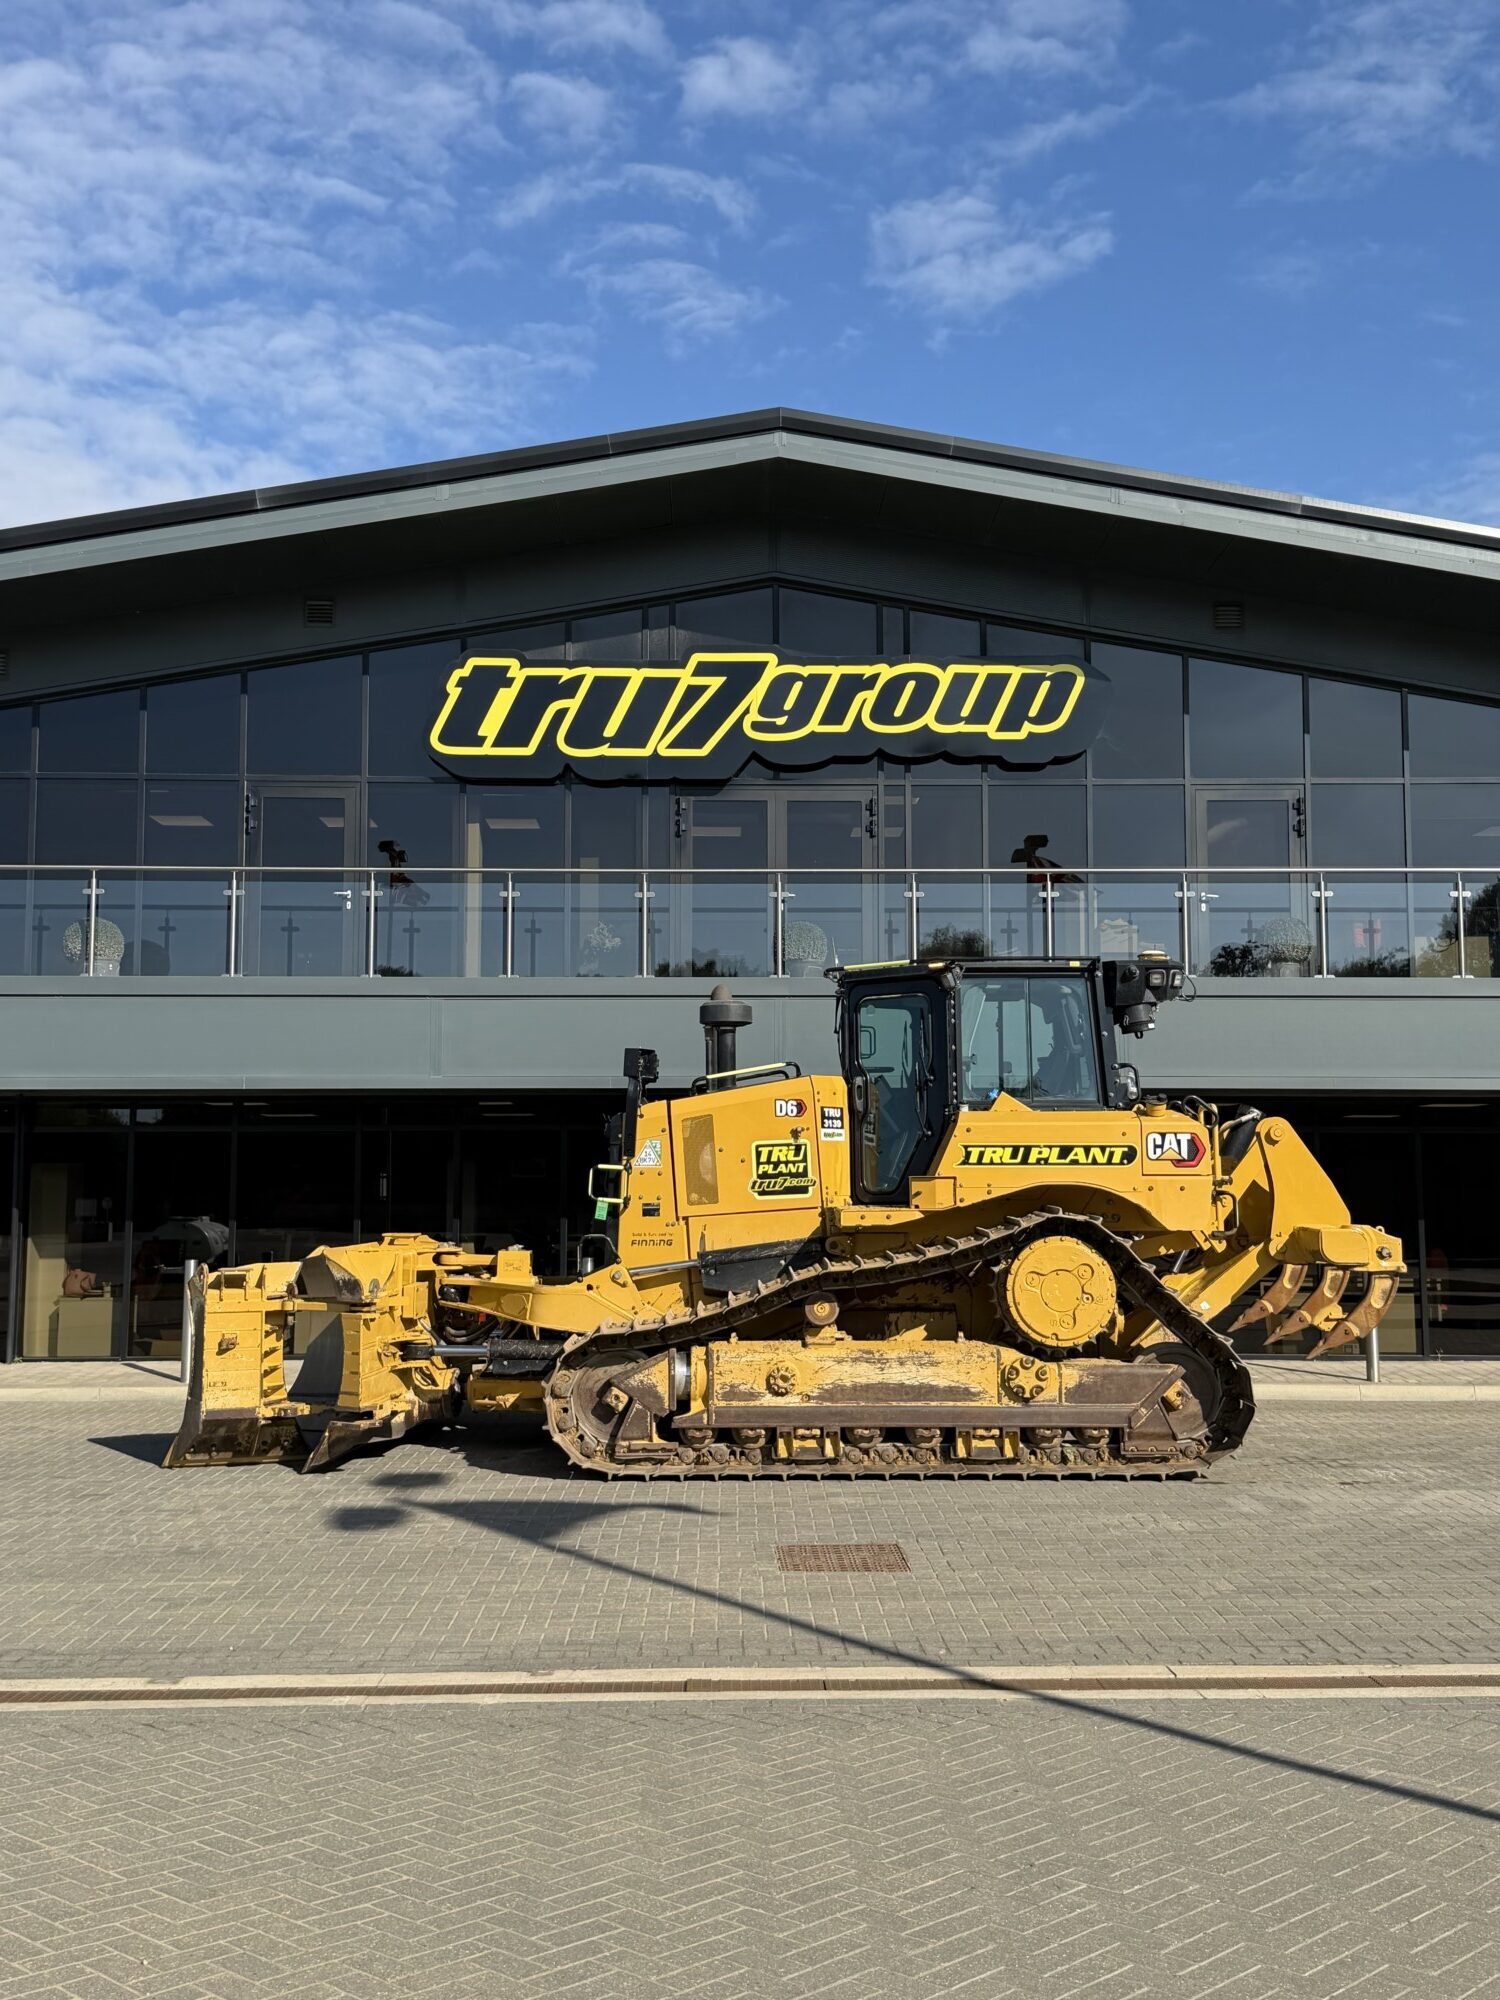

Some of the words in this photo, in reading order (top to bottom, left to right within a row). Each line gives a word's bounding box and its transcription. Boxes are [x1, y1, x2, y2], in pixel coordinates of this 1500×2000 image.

[429, 652, 1085, 757] tru7group
[775, 1099, 798, 1117] D6
[823, 1107, 841, 1118] TRU
[758, 1145, 806, 1162] TRU
[966, 1146, 1025, 1163] TRU
[1027, 1147, 1129, 1163] PLANT
[1146, 1132, 1192, 1160] CAT
[758, 1162, 807, 1174] PLANT
